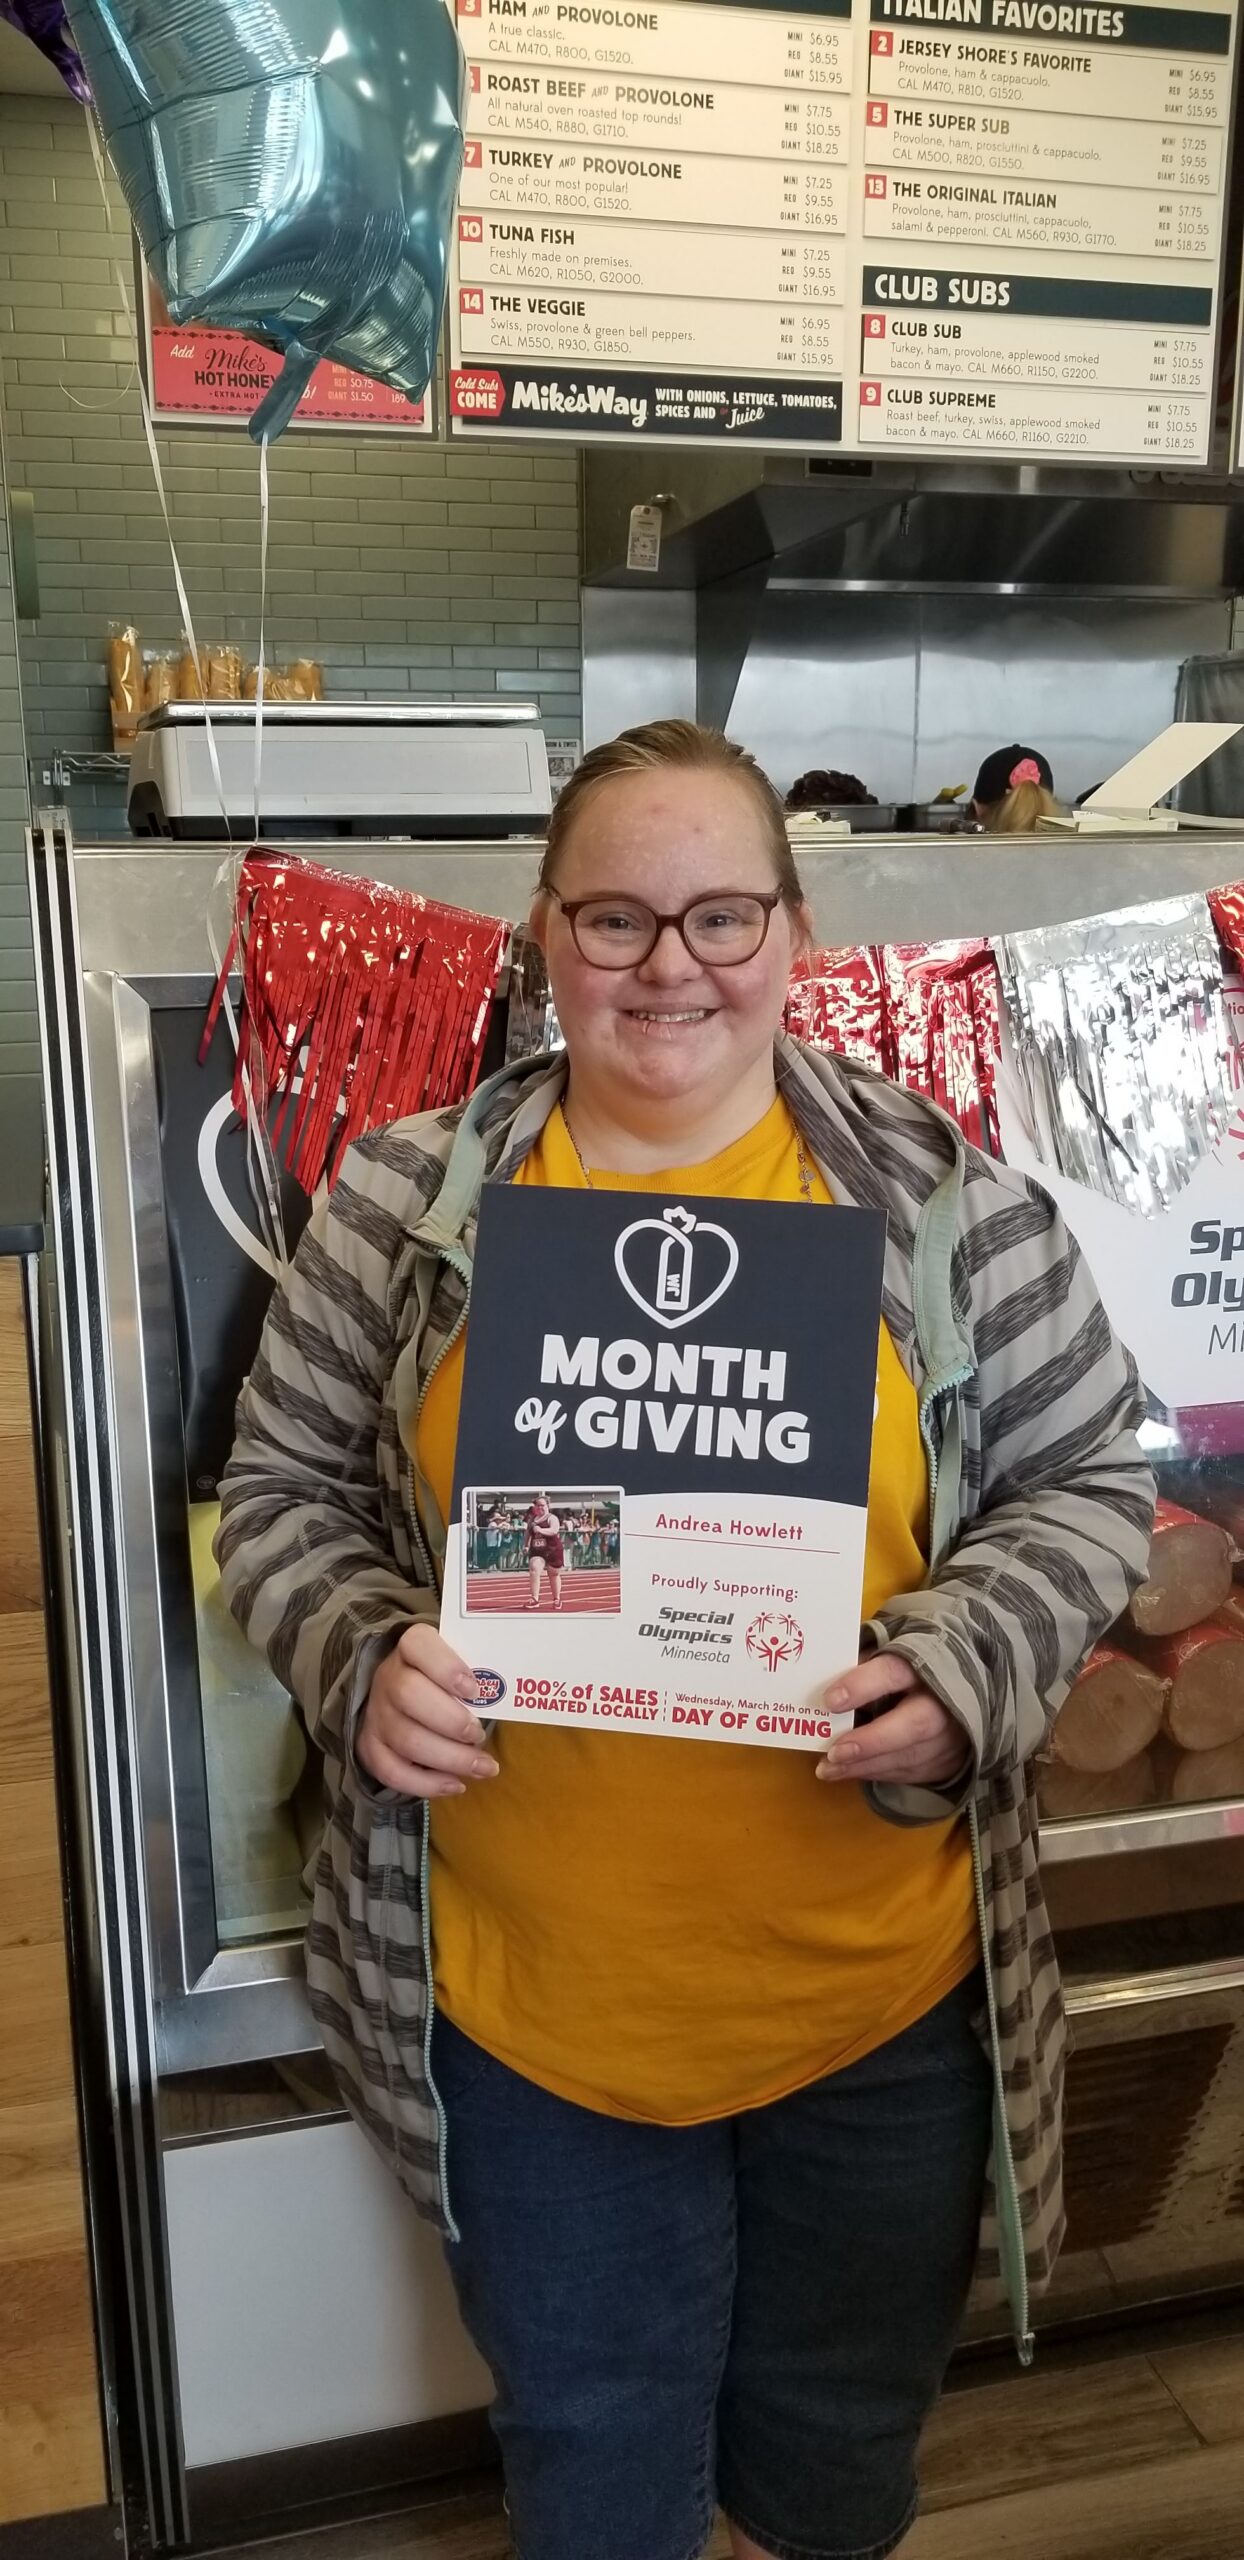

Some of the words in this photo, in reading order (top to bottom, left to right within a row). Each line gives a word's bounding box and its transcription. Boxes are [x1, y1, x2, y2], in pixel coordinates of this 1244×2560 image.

[488, 0, 526, 17] HAM
[557, 5, 658, 30] PROVOLONE
[883, 0, 981, 24] ITALIAN
[992, 8, 1123, 37] FAVORITES
[488, 21, 496, 33] A
[500, 23, 522, 36] true
[526, 25, 565, 40] classic.
[877, 35, 887, 52] 2
[899, 39, 951, 58] JERSEY
[957, 45, 1017, 65] SHORE'S
[1023, 52, 1091, 73] FAVORITE
[898, 60, 950, 78] Provolone,
[954, 66, 976, 78] ham
[487, 74, 540, 94] ROAST
[546, 79, 585, 98] BEEF
[615, 86, 714, 109] PROVOLONE
[487, 96, 500, 109] All
[505, 100, 543, 113] natural
[546, 105, 573, 115] oven
[577, 107, 617, 120] roasted
[621, 109, 639, 124] top
[643, 112, 681, 125] rounds!
[872, 106, 882, 123] 5
[893, 109, 922, 126] THE
[928, 113, 976, 131] SUPER
[981, 118, 1009, 134] SUB
[893, 131, 945, 147] Provolone,
[948, 136, 972, 150] ham,
[464, 146, 475, 163] 7
[488, 149, 553, 169] TURKEY
[583, 157, 682, 179] PROVOLONE
[489, 171, 514, 185] One
[517, 173, 530, 186] of
[533, 178, 551, 187] our
[555, 179, 580, 190] most
[585, 180, 628, 194] popular!
[868, 178, 884, 195] 13
[892, 181, 921, 198] THE
[927, 184, 997, 204] ORIGINAL
[1003, 190, 1056, 208] ITALIAN
[461, 221, 481, 238] 10
[489, 224, 534, 242] TUNA
[541, 228, 574, 245] FISH
[891, 219, 922, 231] salami
[937, 225, 988, 237] pepperoni.
[489, 246, 527, 264] Freshly
[531, 250, 561, 262] made
[565, 255, 579, 263] on
[583, 256, 632, 267] premises.
[803, 248, 830, 261] $7.25
[489, 263, 512, 276] CAL
[516, 264, 552, 280] M620,
[557, 267, 595, 283] R1050,
[599, 271, 643, 285] G2000.
[802, 265, 831, 279] $9.55
[802, 283, 836, 296] $16.95
[874, 273, 938, 301] CLUB
[948, 278, 1010, 306] SUBS
[463, 293, 481, 309] 14
[489, 296, 521, 312] THE
[527, 298, 585, 316] VEGGIE
[490, 317, 522, 332] Swiss,
[526, 321, 579, 334] provolone
[595, 327, 625, 338] green
[629, 325, 647, 338] bell
[651, 330, 695, 342] peppers.
[801, 316, 830, 330] $6.95
[870, 318, 880, 334] 8
[891, 321, 927, 337] CLUB
[933, 323, 961, 339] SUB
[490, 334, 513, 347] CAL
[517, 336, 553, 350] M550,
[558, 338, 590, 352] R930,
[593, 340, 631, 353] G1850.
[801, 334, 829, 347] $8.55
[170, 344, 194, 359] Add
[204, 346, 266, 372] Mike's
[800, 351, 833, 365] $15.95
[891, 341, 923, 357] Turkey,
[927, 344, 951, 357] ham,
[954, 346, 1004, 360] provolone,
[1007, 349, 1061, 362] applewood
[1063, 352, 1100, 364] smoked
[890, 357, 920, 369] bacon
[935, 363, 963, 375] mayo.
[194, 370, 224, 386] HOT
[350, 378, 373, 388] $0.75
[454, 376, 477, 389] Cold
[477, 378, 498, 391] Subs
[214, 391, 240, 399] EXTRA
[351, 392, 373, 402] $1.50
[392, 394, 406, 403] 189
[457, 391, 496, 409] COME
[655, 388, 683, 401] WITH
[686, 389, 729, 404] ONIONS,
[733, 392, 778, 407] LETTUCE,
[781, 394, 837, 409] TOMATOES,
[865, 386, 876, 402] 9
[887, 389, 922, 404] CLUB
[928, 391, 996, 408] SUPREME
[655, 404, 690, 418] SPICES
[693, 406, 716, 419] AND
[725, 406, 765, 429] Juice
[1167, 403, 1190, 416] $7.75
[886, 409, 913, 421] Roast
[917, 410, 940, 423] beef,
[944, 412, 975, 426] turkey,
[978, 415, 1006, 426] swiss,
[1009, 416, 1061, 429] applewood
[1064, 418, 1101, 430] smoked
[1166, 420, 1197, 432] $10.55
[885, 424, 916, 436] bacon
[930, 430, 958, 441] mayo.
[962, 428, 982, 439] CAL
[986, 429, 1018, 442] M660,
[1021, 431, 1052, 444] R1160,
[1055, 432, 1089, 444] G2210.
[1165, 436, 1194, 449] $18.25
[540, 1334, 786, 1400] MONTH
[514, 1397, 567, 1454] of
[574, 1396, 810, 1464] GIVING
[655, 1514, 722, 1534] Andrea
[731, 1520, 803, 1541] Howlett
[652, 1574, 708, 1594] Proudly
[713, 1578, 798, 1602] Supporting:
[659, 1607, 734, 1625] Special
[638, 1624, 733, 1644] Olympics
[661, 1645, 730, 1663] Minnesota
[516, 1678, 567, 1697] 100%
[572, 1684, 593, 1700] of
[600, 1686, 658, 1706] SALES
[514, 1696, 587, 1713] DONATED
[593, 1703, 658, 1720] LOCALLY
[675, 1692, 734, 1709] Wednesday,
[738, 1699, 769, 1711] March
[773, 1702, 795, 1714] 26th
[672, 1707, 714, 1725] DAY
[720, 1711, 749, 1729] OF
[756, 1716, 831, 1738] GIVING
